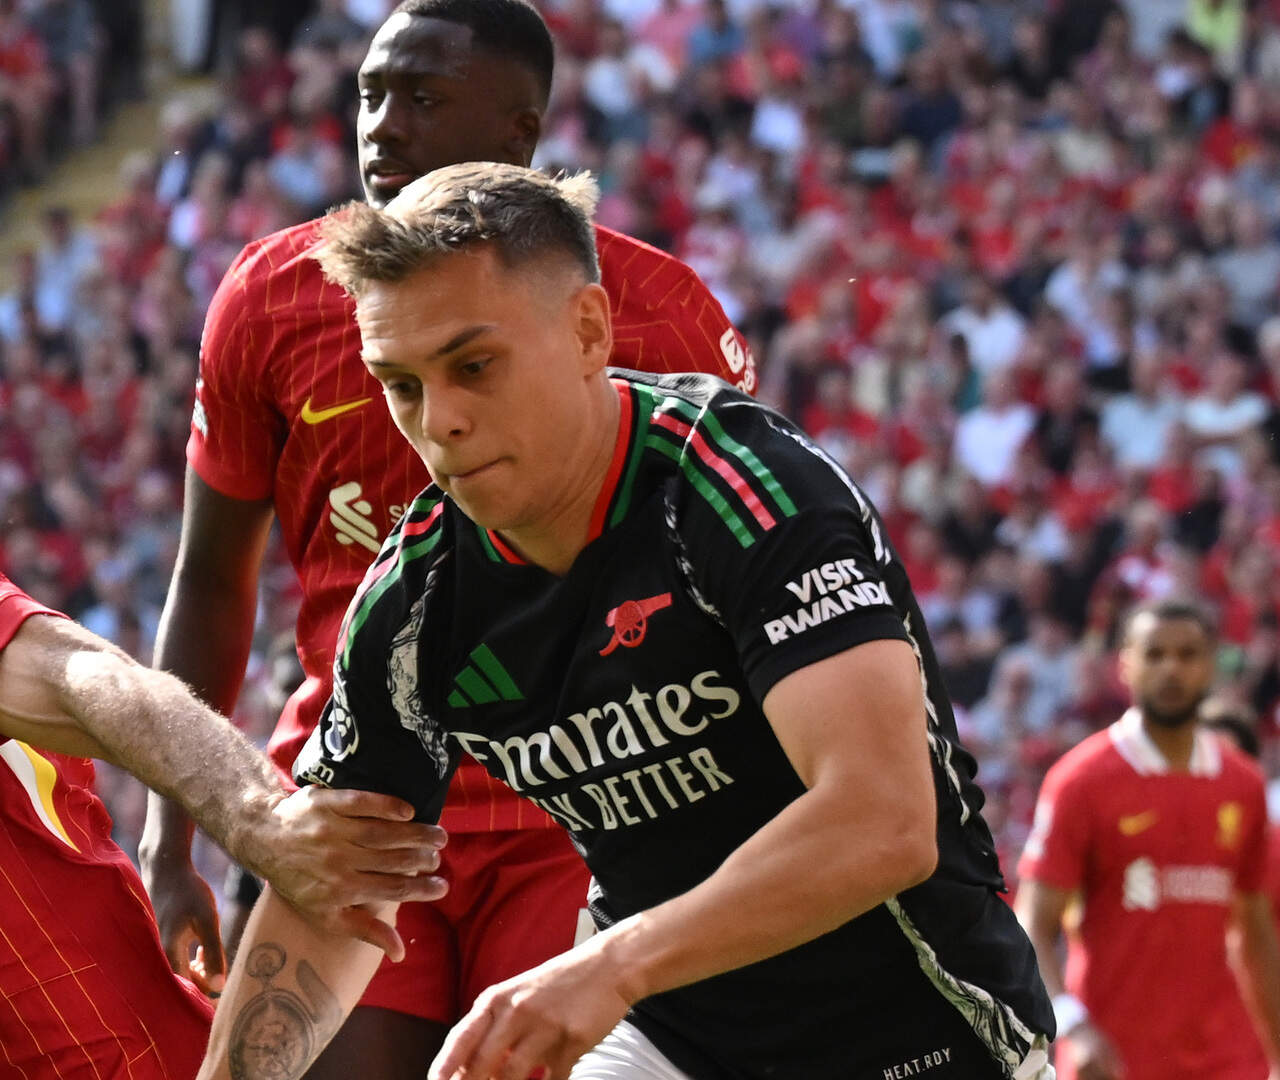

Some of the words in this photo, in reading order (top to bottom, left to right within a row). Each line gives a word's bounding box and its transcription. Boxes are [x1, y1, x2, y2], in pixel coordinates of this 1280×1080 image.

[785, 558, 864, 603] VISIT
[449, 670, 740, 792] Emirates
[528, 793, 595, 831] LY
[581, 747, 735, 831] BETTER
